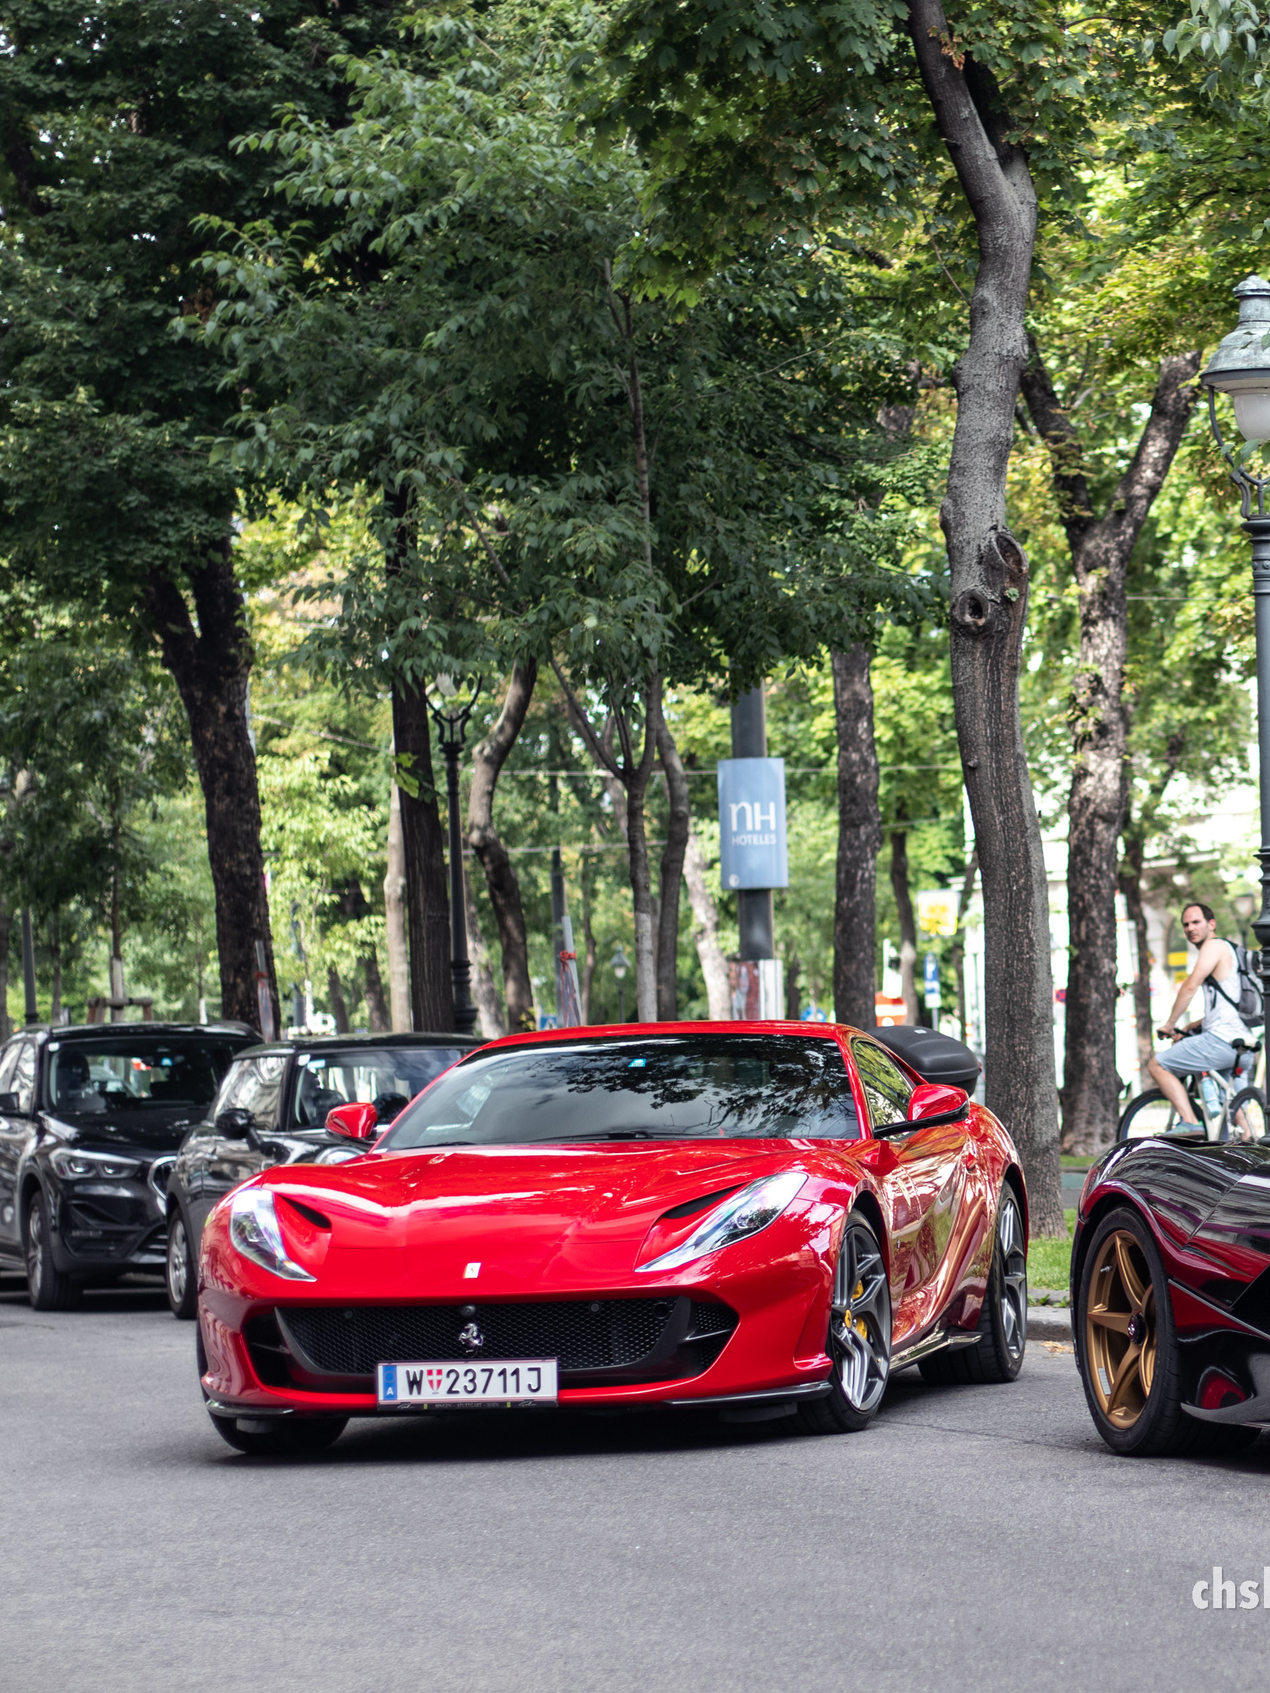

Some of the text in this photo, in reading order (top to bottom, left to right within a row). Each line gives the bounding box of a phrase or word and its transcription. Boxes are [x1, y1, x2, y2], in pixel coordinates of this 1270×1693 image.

[731, 833, 776, 846] HOTELES
[405, 1369, 424, 1396] W
[386, 1387, 394, 1396] A
